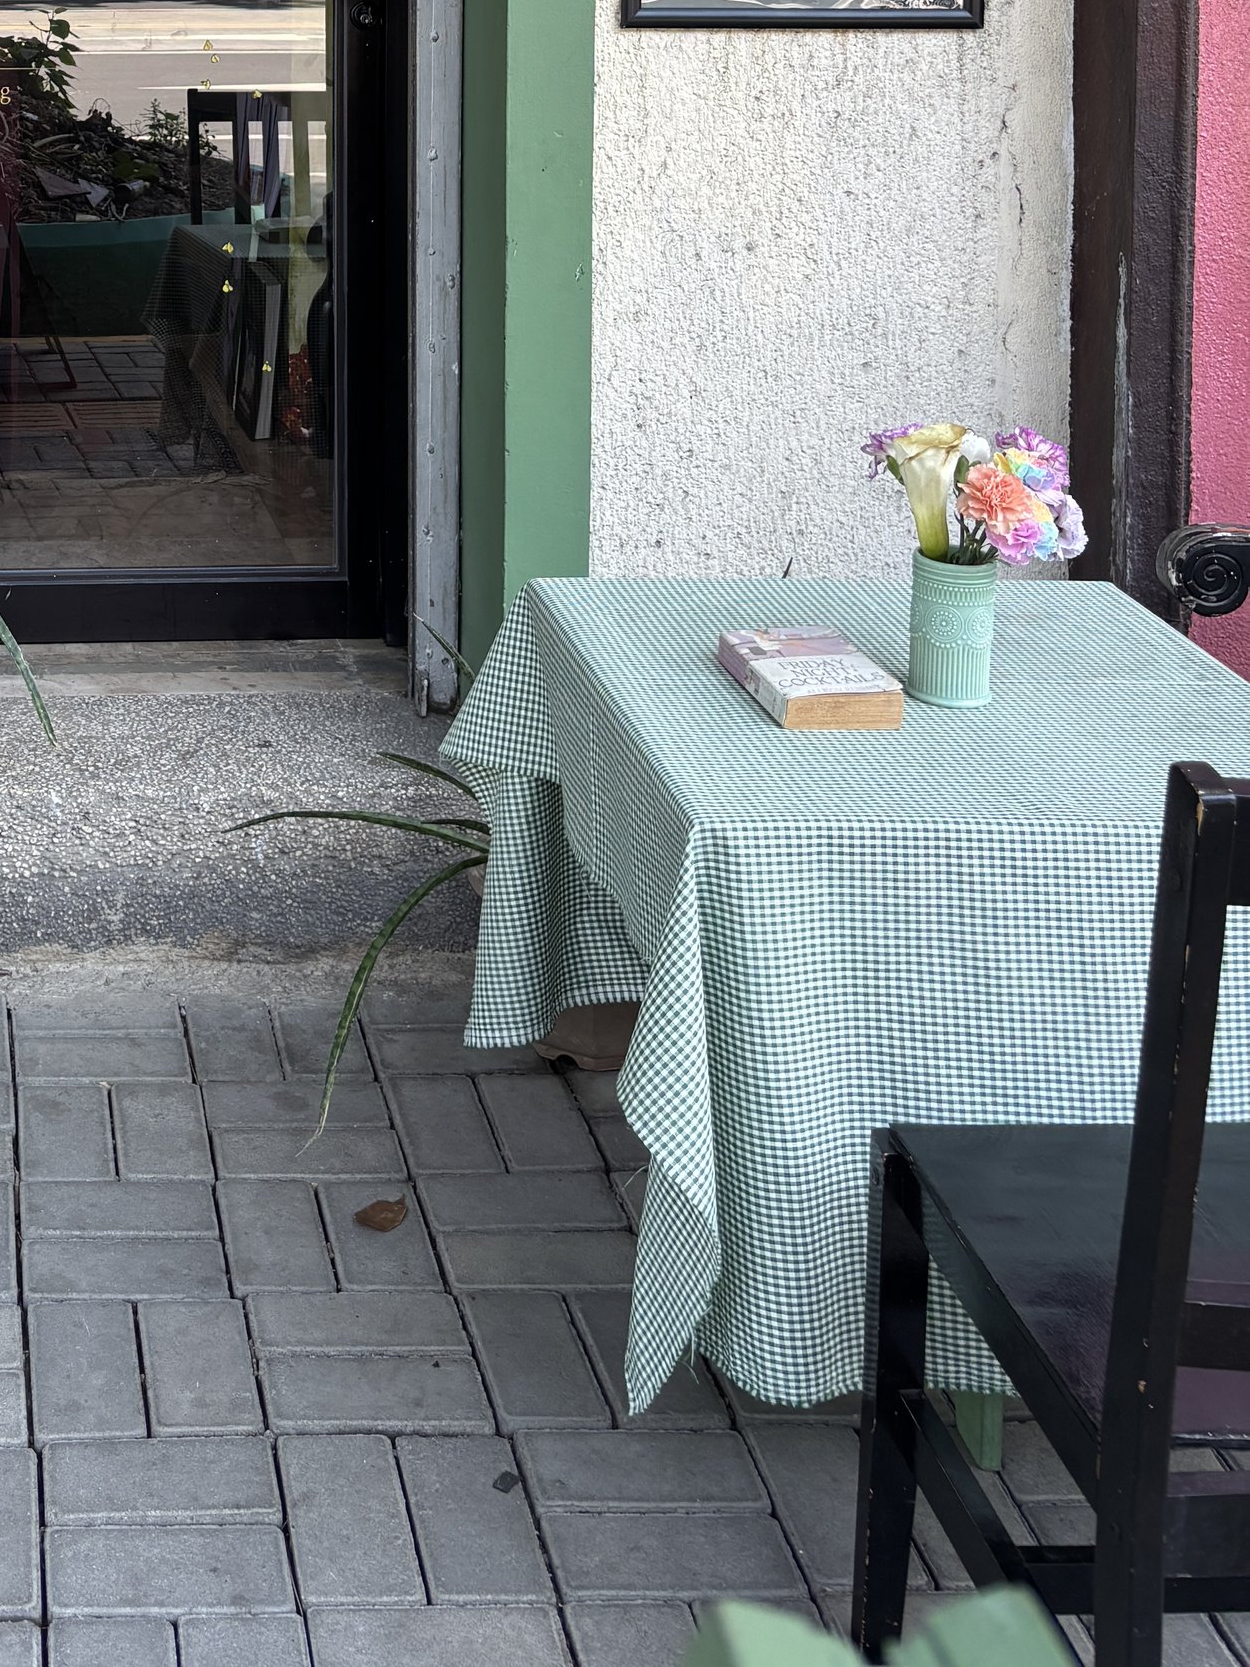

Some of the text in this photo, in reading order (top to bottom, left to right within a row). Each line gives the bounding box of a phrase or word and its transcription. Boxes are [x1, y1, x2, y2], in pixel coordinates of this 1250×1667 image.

[777, 658, 845, 670] FRIDAY
[790, 667, 850, 678] NIGHT
[778, 672, 885, 688] COCKTAILS
